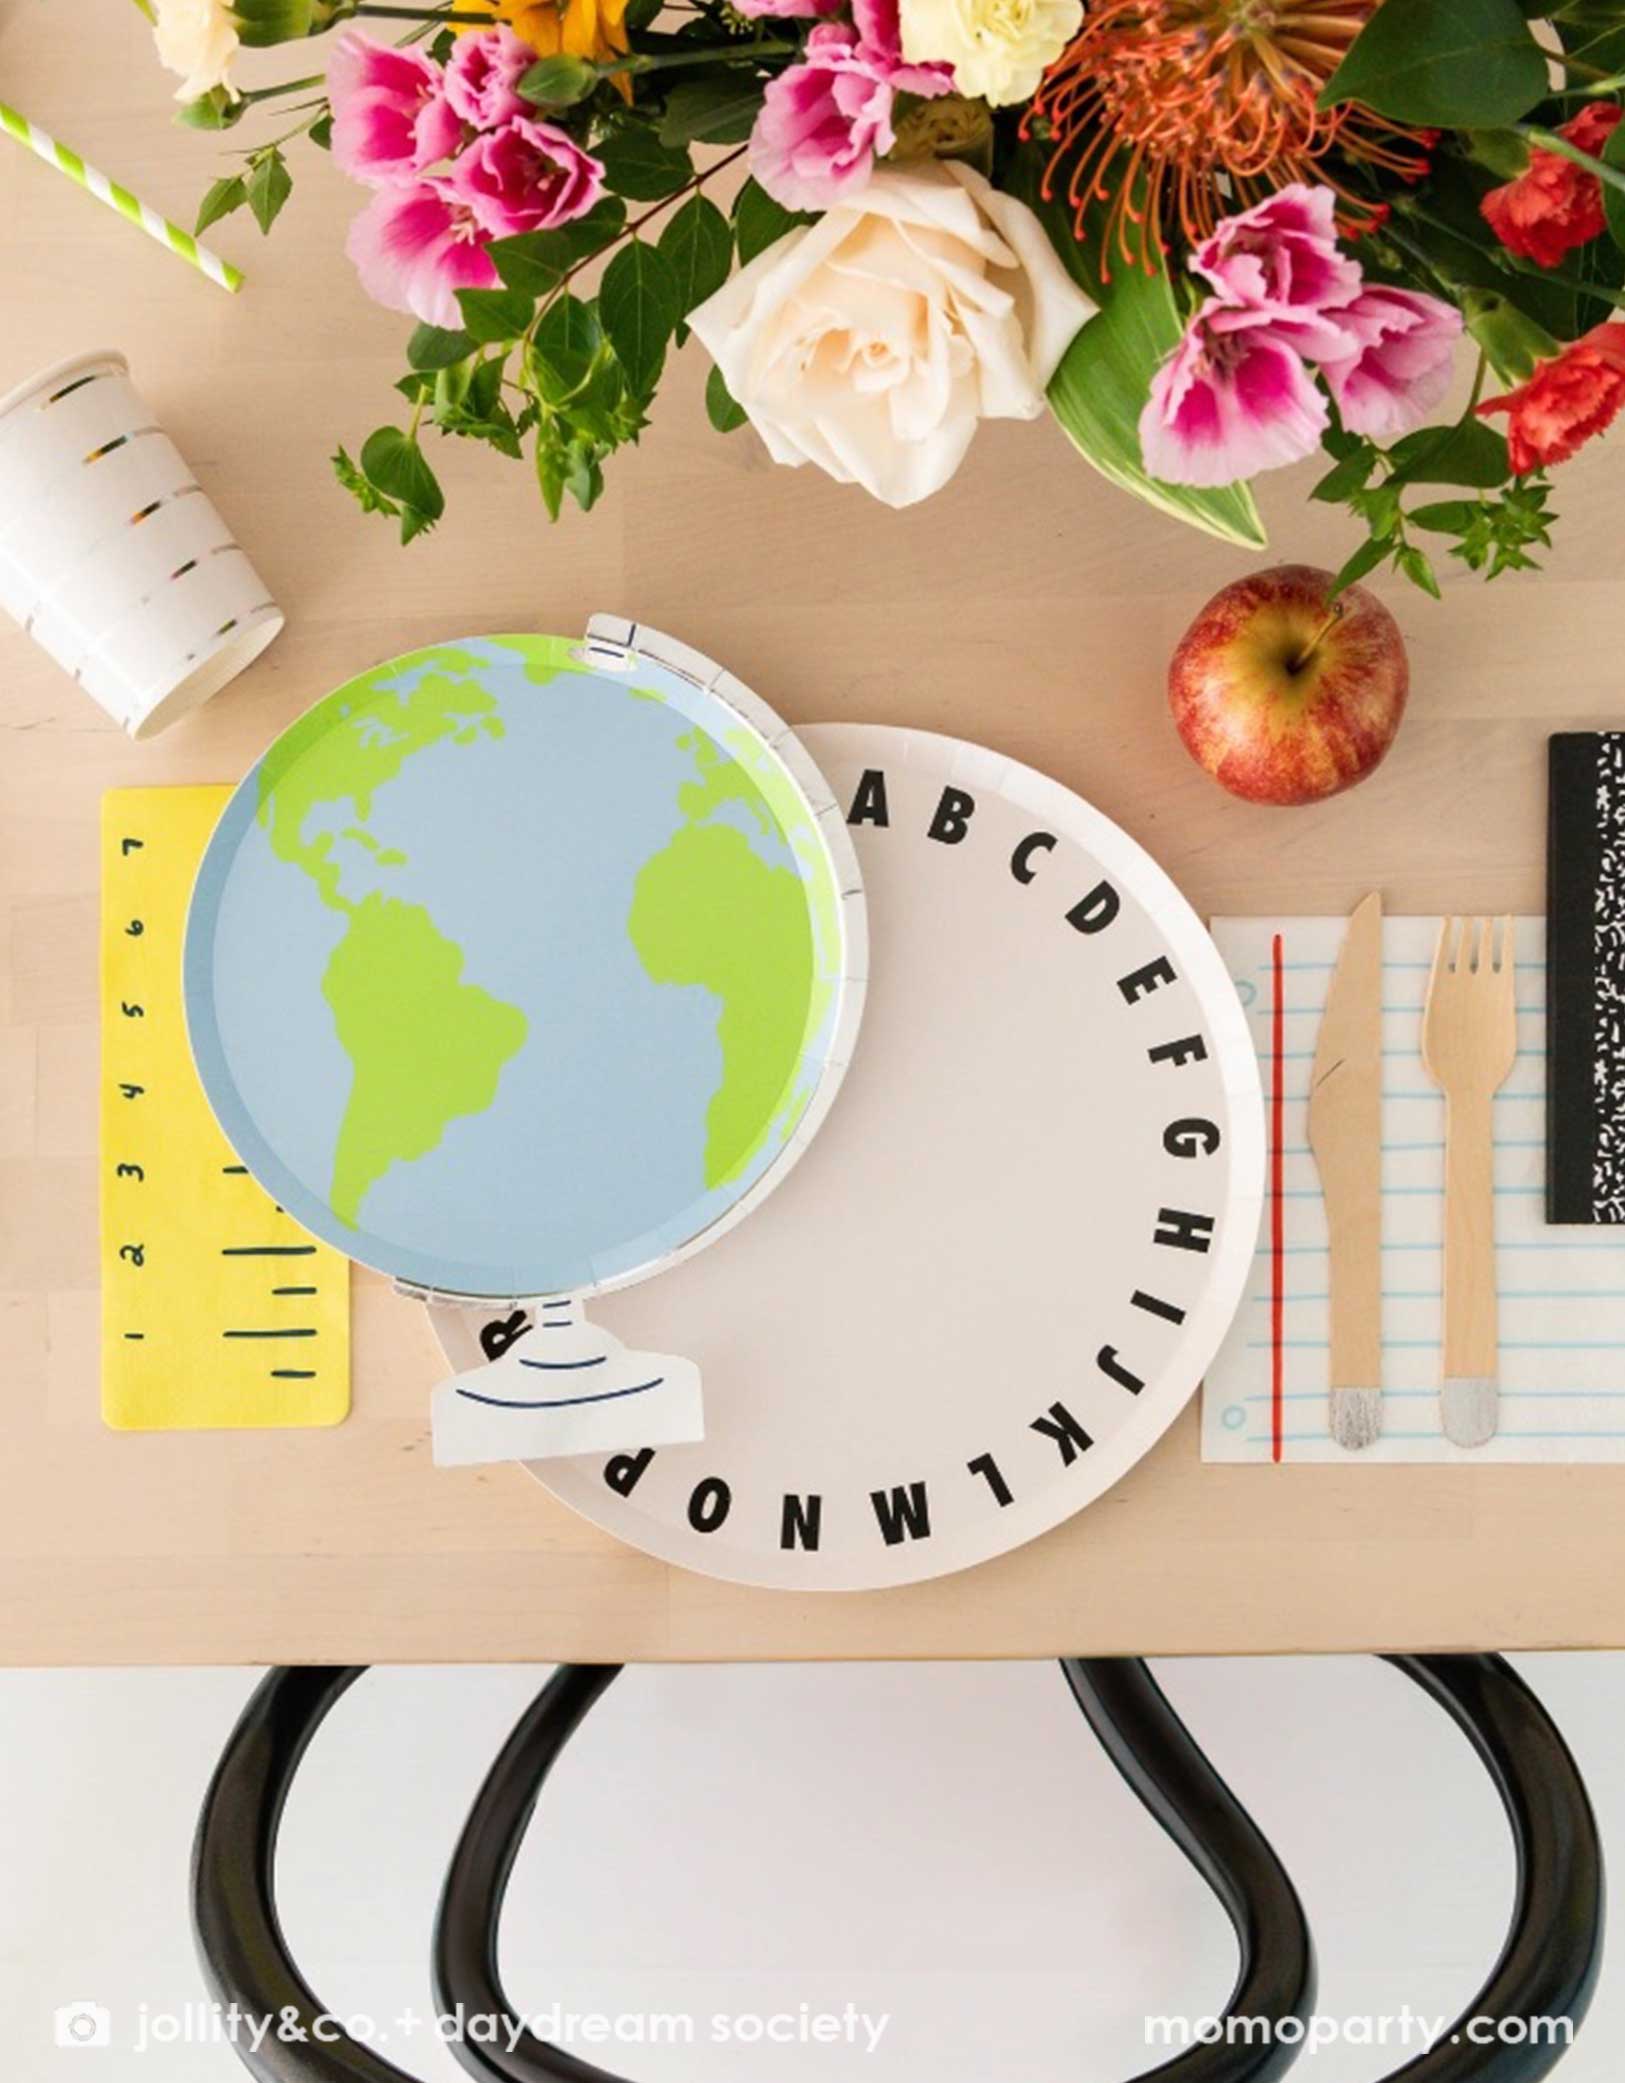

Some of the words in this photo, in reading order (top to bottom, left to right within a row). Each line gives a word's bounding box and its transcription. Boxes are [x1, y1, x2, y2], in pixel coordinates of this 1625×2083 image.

[846, 769, 889, 828] A
[927, 785, 975, 845] B
[122, 838, 144, 856] 7
[1010, 832, 1058, 885] C
[125, 919, 144, 937] 6
[1065, 880, 1120, 935] D
[1116, 955, 1177, 1005] E
[121, 1001, 144, 1018] 5
[1147, 1034, 1208, 1067] F
[119, 1083, 145, 1100] 4
[1163, 1118, 1220, 1158] G
[116, 1163, 144, 1182] 3
[119, 1244, 144, 1267] 2
[1153, 1207, 1215, 1253] H
[1130, 1290, 1186, 1325] I
[479, 1309, 534, 1362] R
[1097, 1345, 1145, 1396] J
[1029, 1401, 1094, 1467] K
[603, 1447, 656, 1498] P
[967, 1453, 1014, 1507] L
[687, 1476, 731, 1534] O
[780, 1494, 822, 1552] N
[870, 1481, 931, 1546] M
